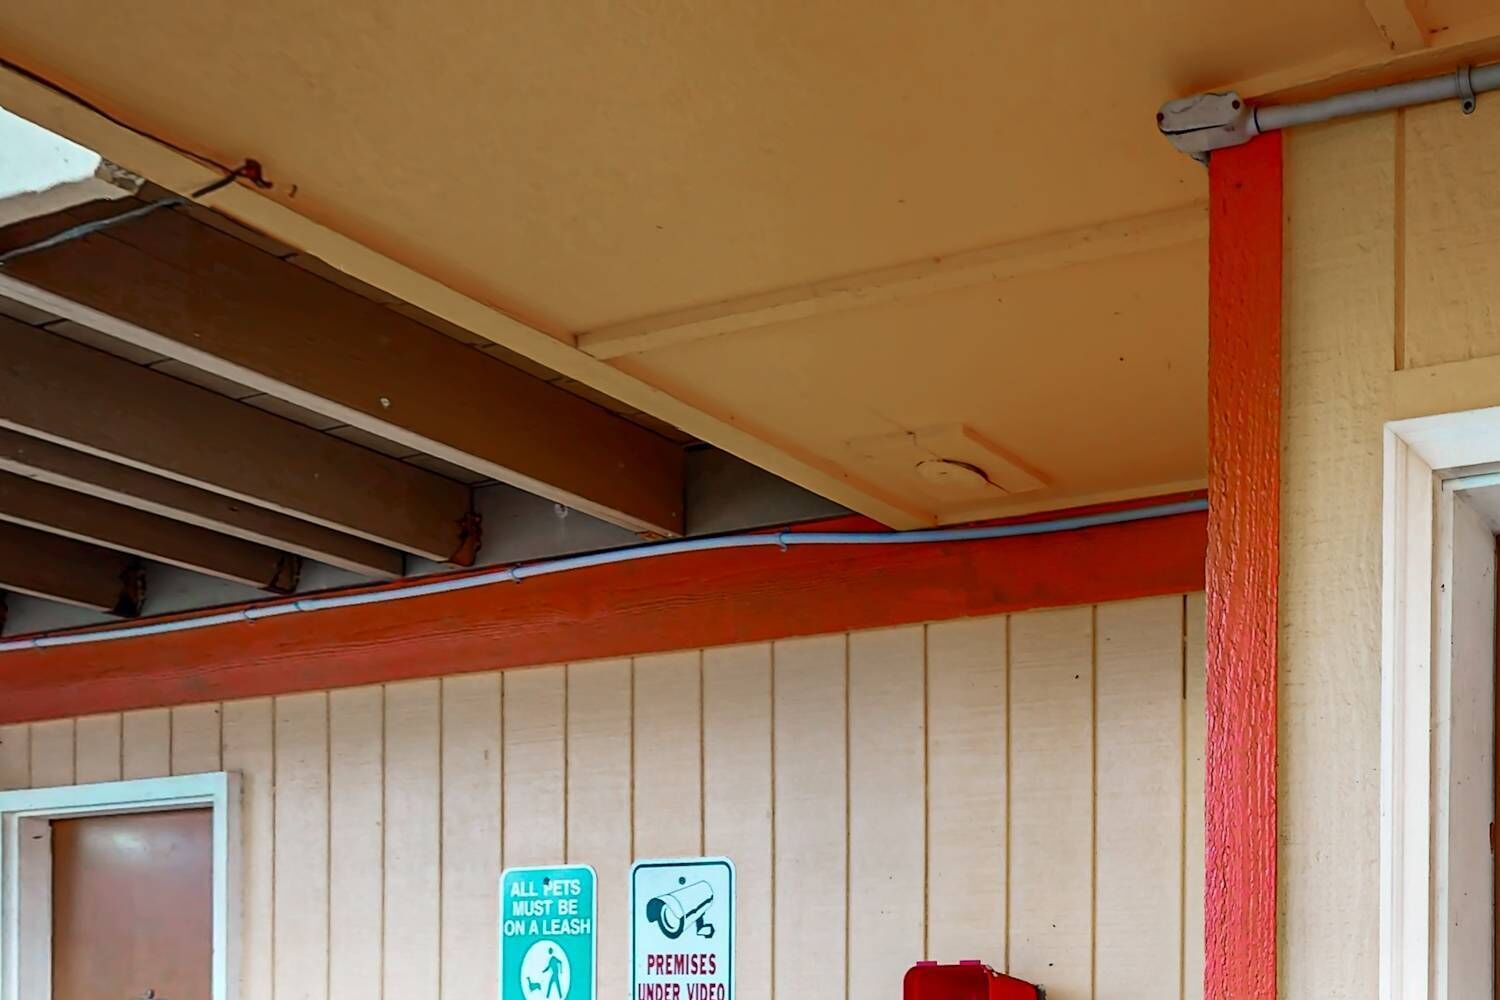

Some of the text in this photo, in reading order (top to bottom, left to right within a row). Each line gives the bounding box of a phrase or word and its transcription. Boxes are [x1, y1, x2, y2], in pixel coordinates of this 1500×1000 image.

[511, 879, 580, 897] ALL PETS
[513, 899, 578, 916] MUST BE
[503, 918, 591, 937] ON A LEASH
[647, 953, 717, 976] PREMISES
